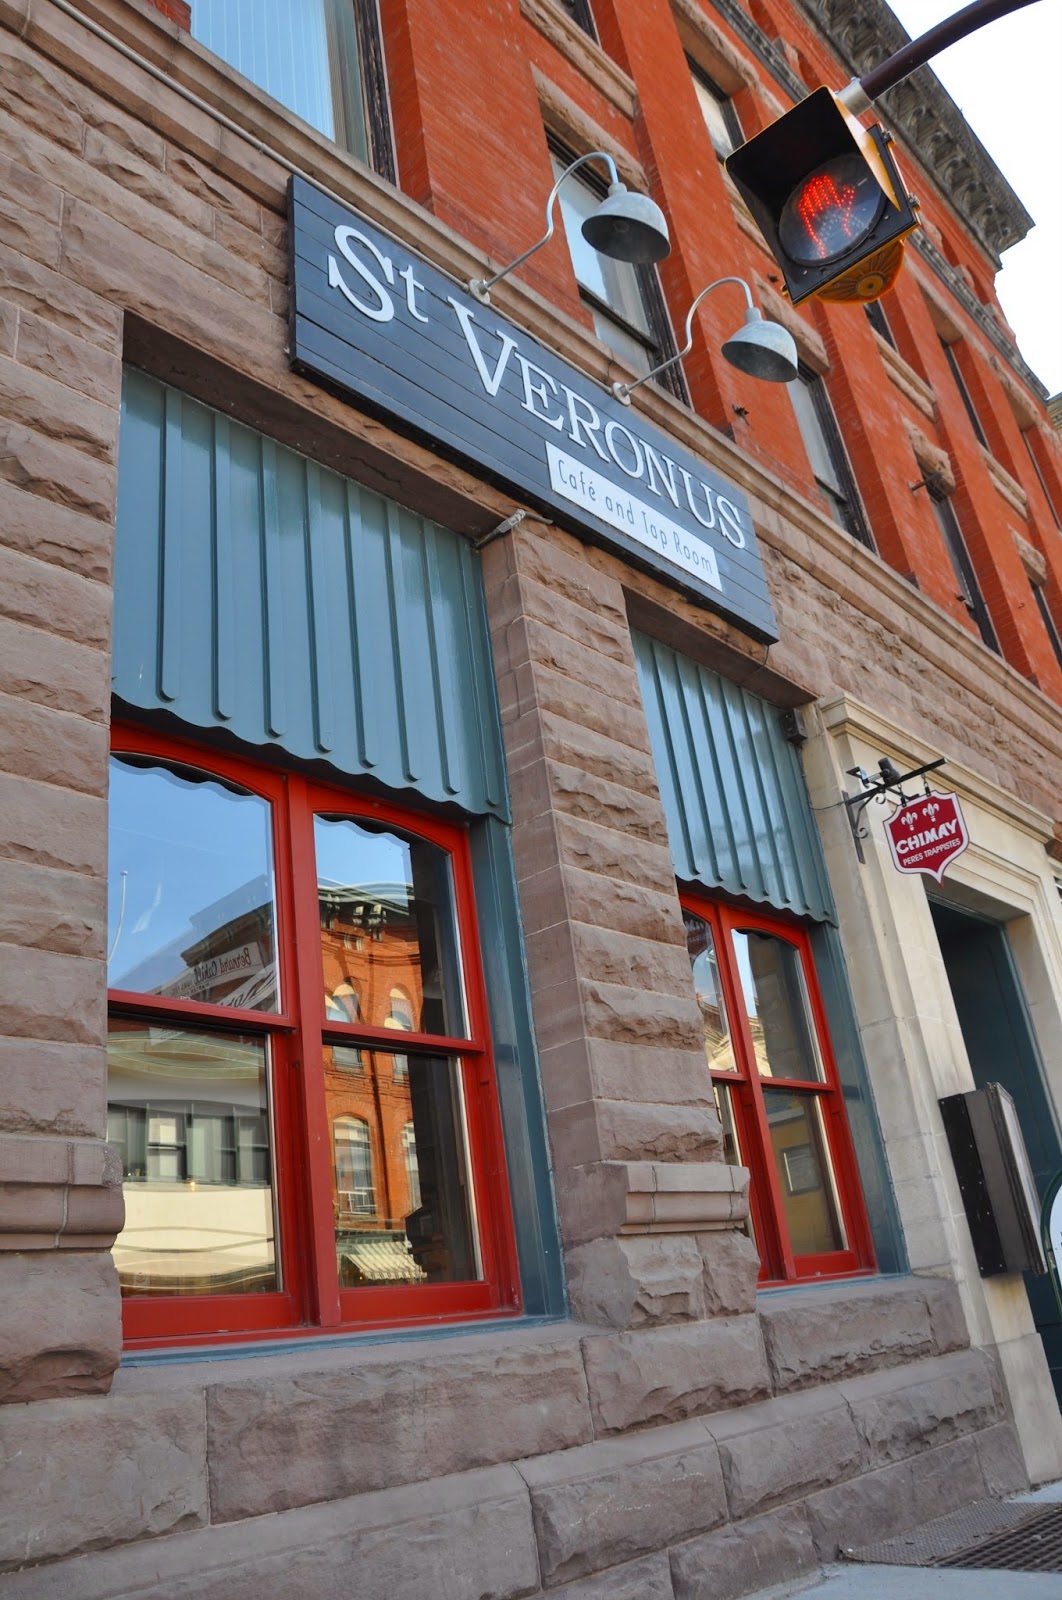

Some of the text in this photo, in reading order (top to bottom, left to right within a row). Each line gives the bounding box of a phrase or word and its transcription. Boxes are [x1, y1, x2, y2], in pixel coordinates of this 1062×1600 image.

[328, 224, 746, 550] St VERONUS
[558, 459, 713, 574] Café and Tap Room
[896, 818, 958, 854] CHIMAY
[903, 838, 960, 866] PERES TRAPPISTES
